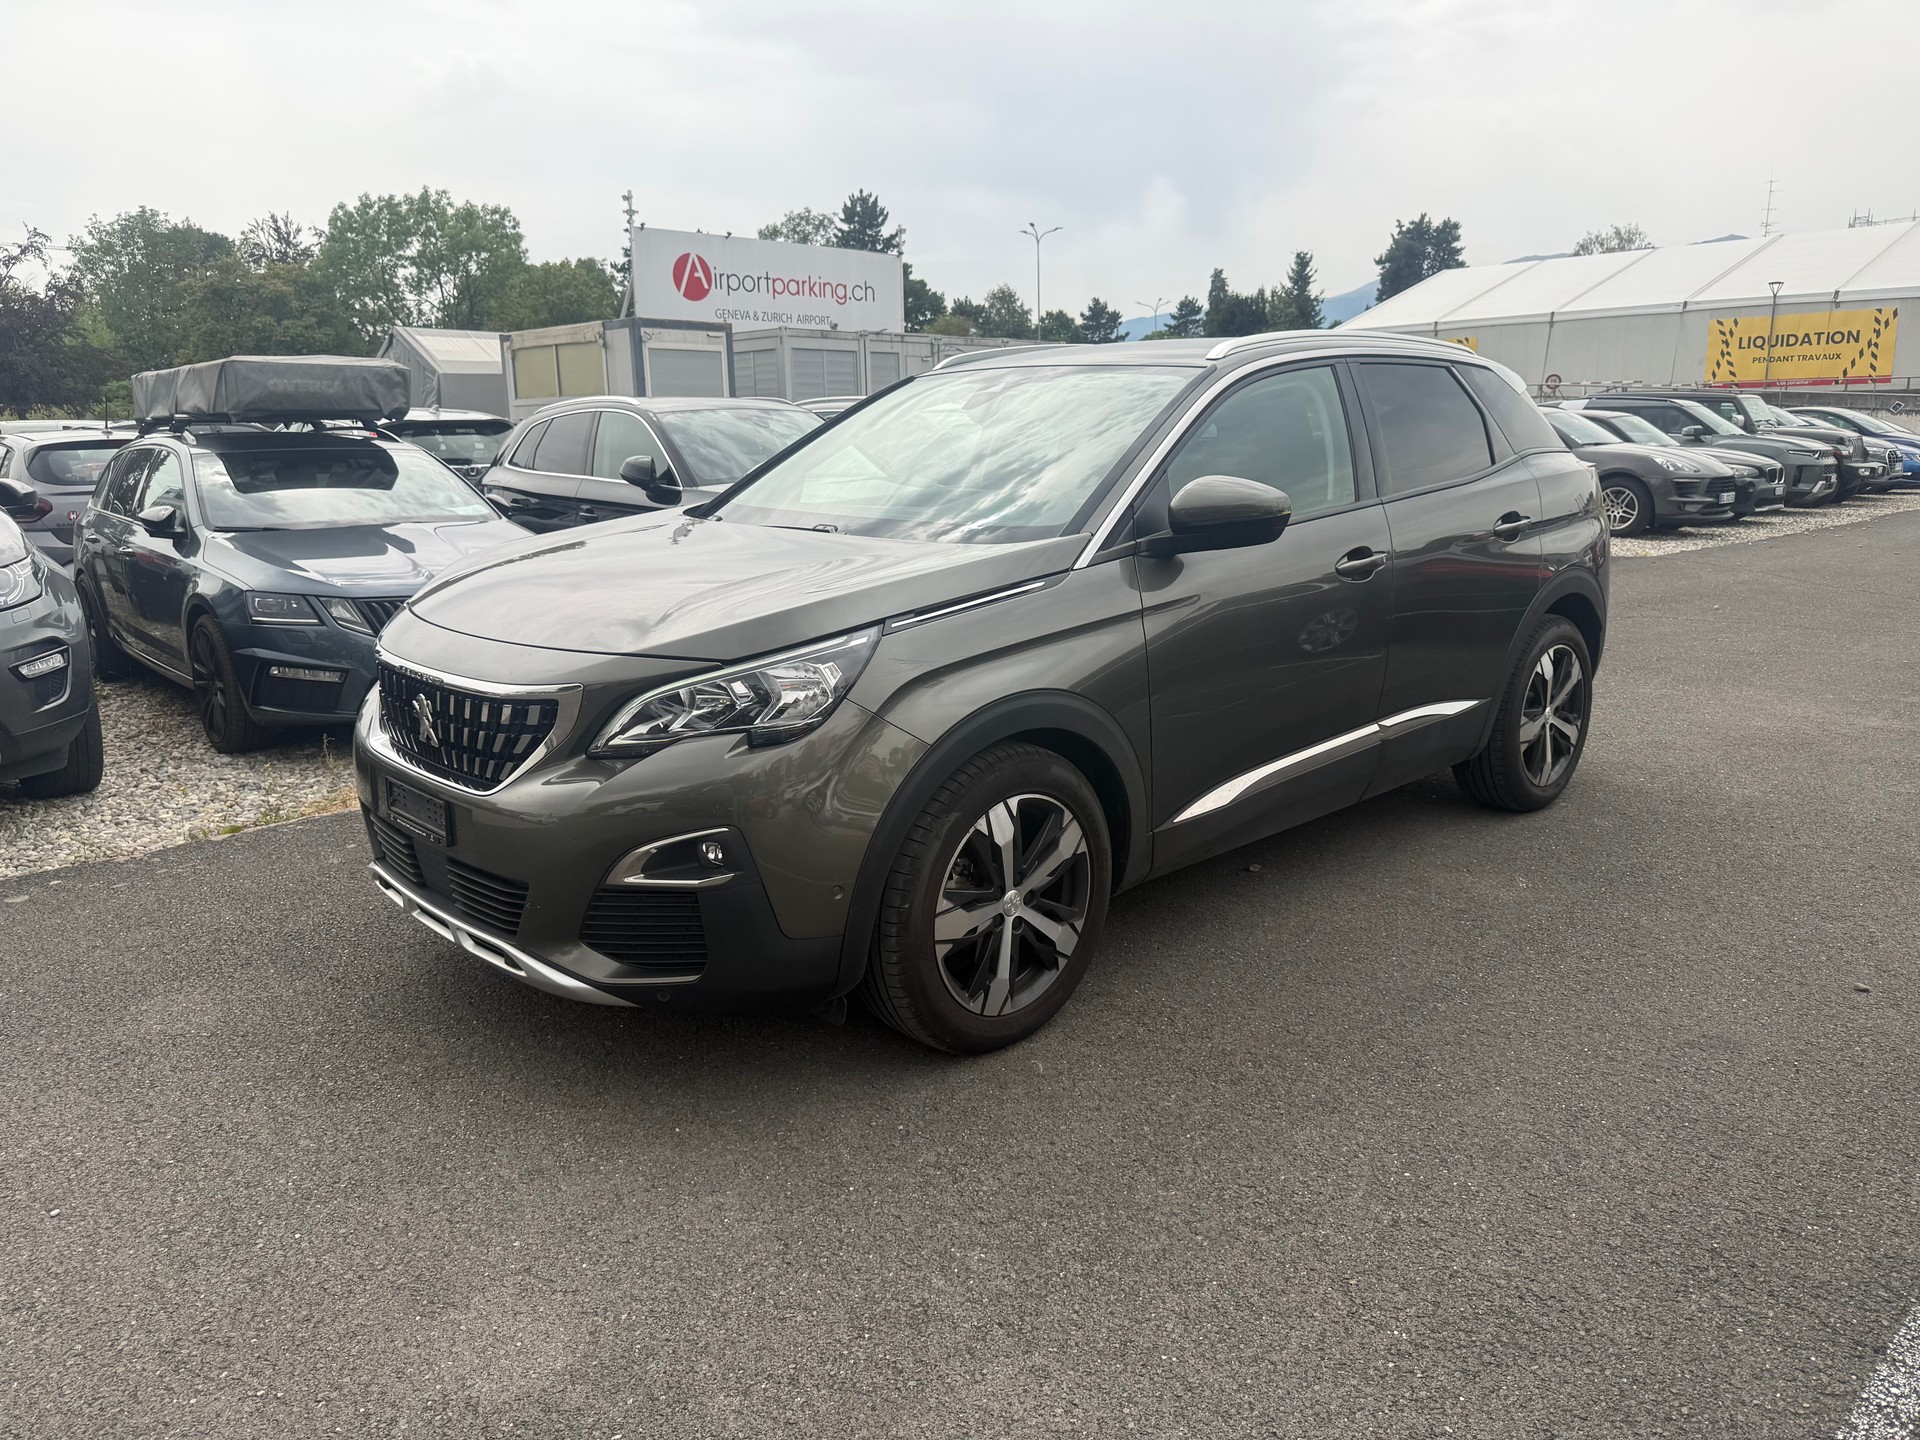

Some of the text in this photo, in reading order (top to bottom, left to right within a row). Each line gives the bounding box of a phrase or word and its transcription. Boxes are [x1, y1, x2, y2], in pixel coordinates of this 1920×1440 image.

[714, 308, 830, 326] GENEVA & ZURICH AIRPORT
[1739, 330, 1860, 350] LIQUIDATION
[1752, 353, 1842, 364] PENDANT TRAVAUX
